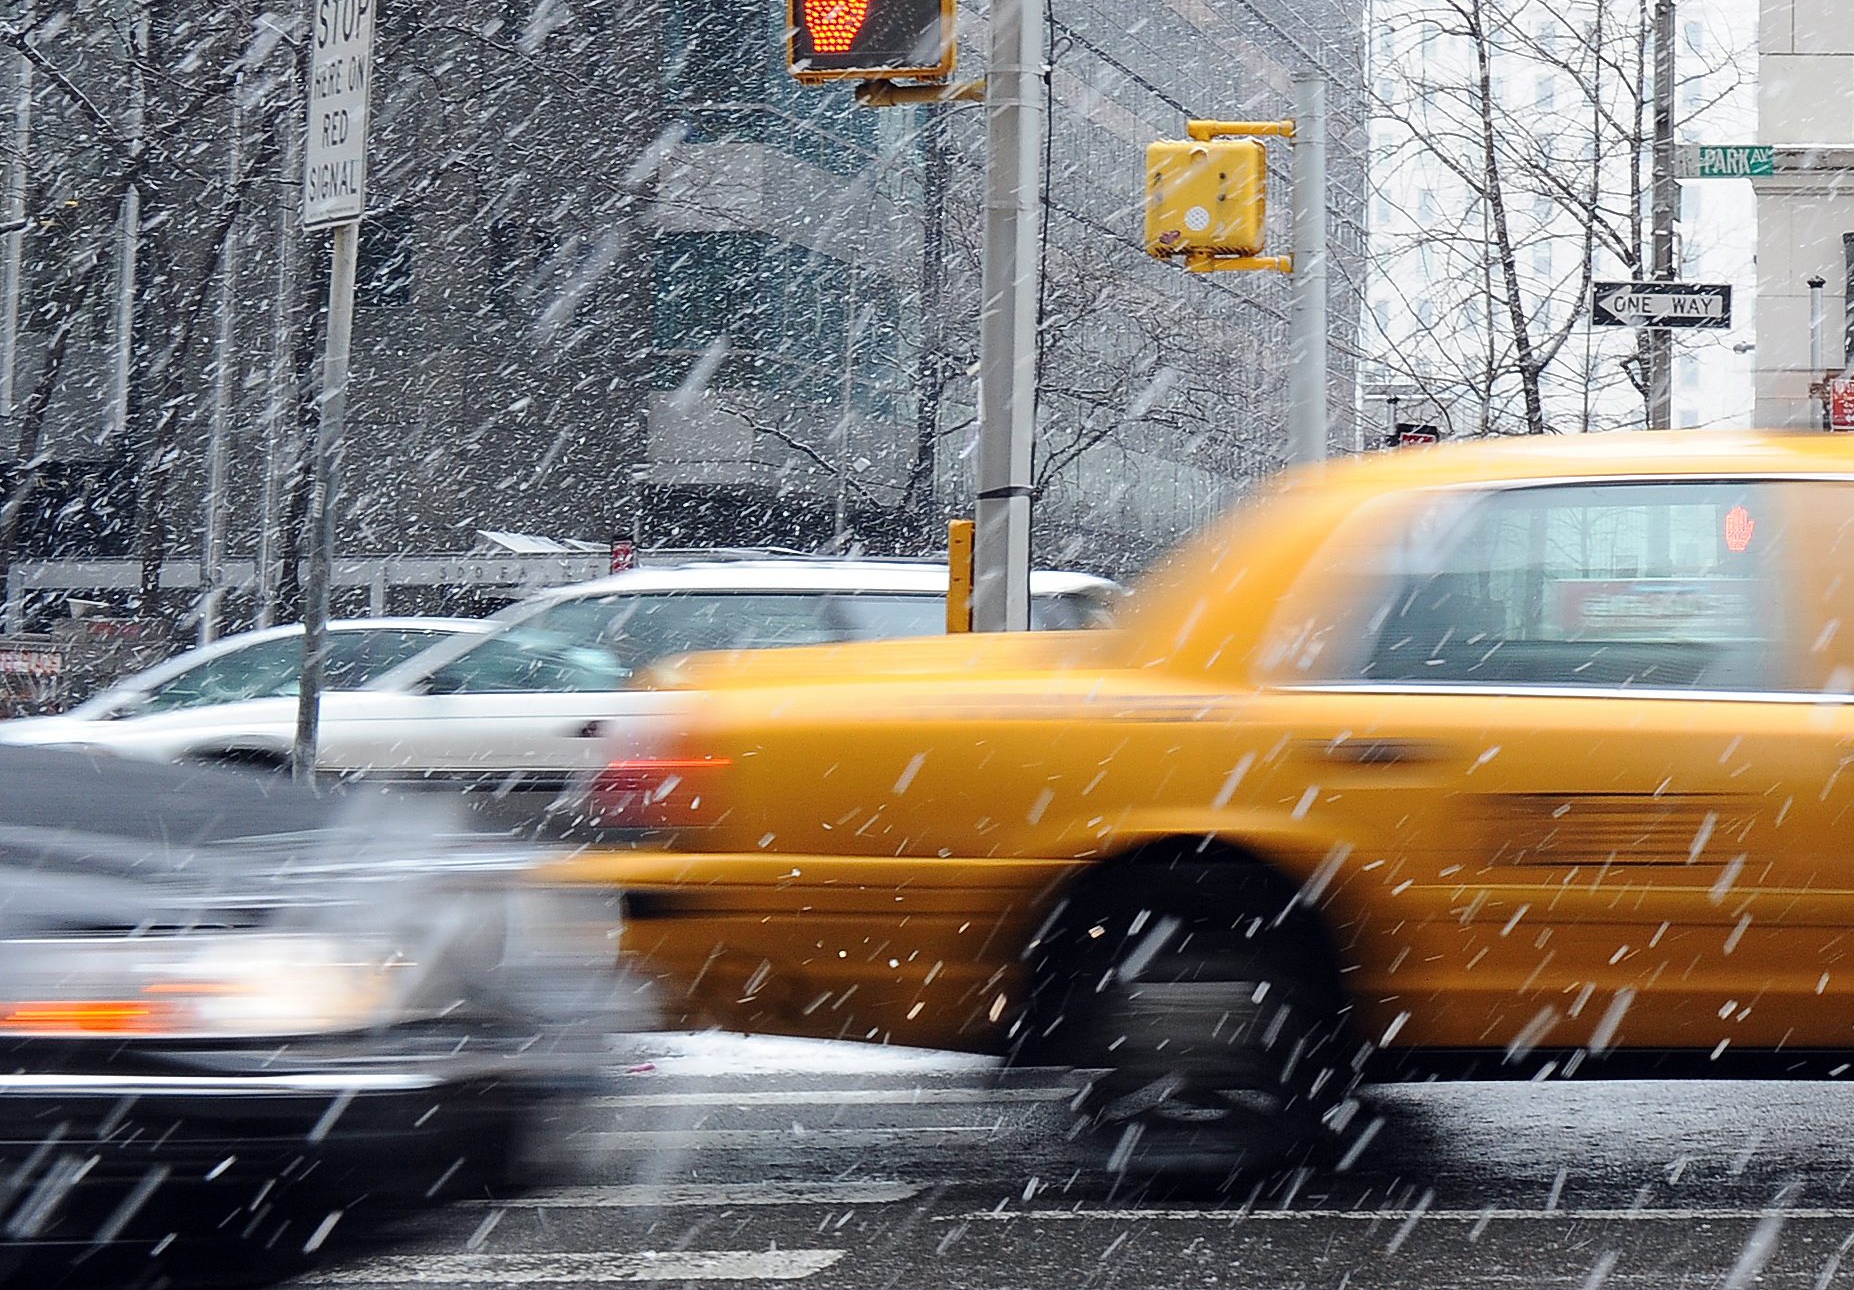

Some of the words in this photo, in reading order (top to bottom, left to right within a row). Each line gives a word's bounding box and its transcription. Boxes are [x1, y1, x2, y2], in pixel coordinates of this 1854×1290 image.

[313, 59, 343, 100] HERE
[348, 55, 365, 91] ON
[321, 109, 349, 148] RED
[308, 159, 359, 202] SIGNAL
[1703, 148, 1751, 174] PARK
[1613, 296, 1653, 314] ONE
[1671, 296, 1713, 315] WAY
